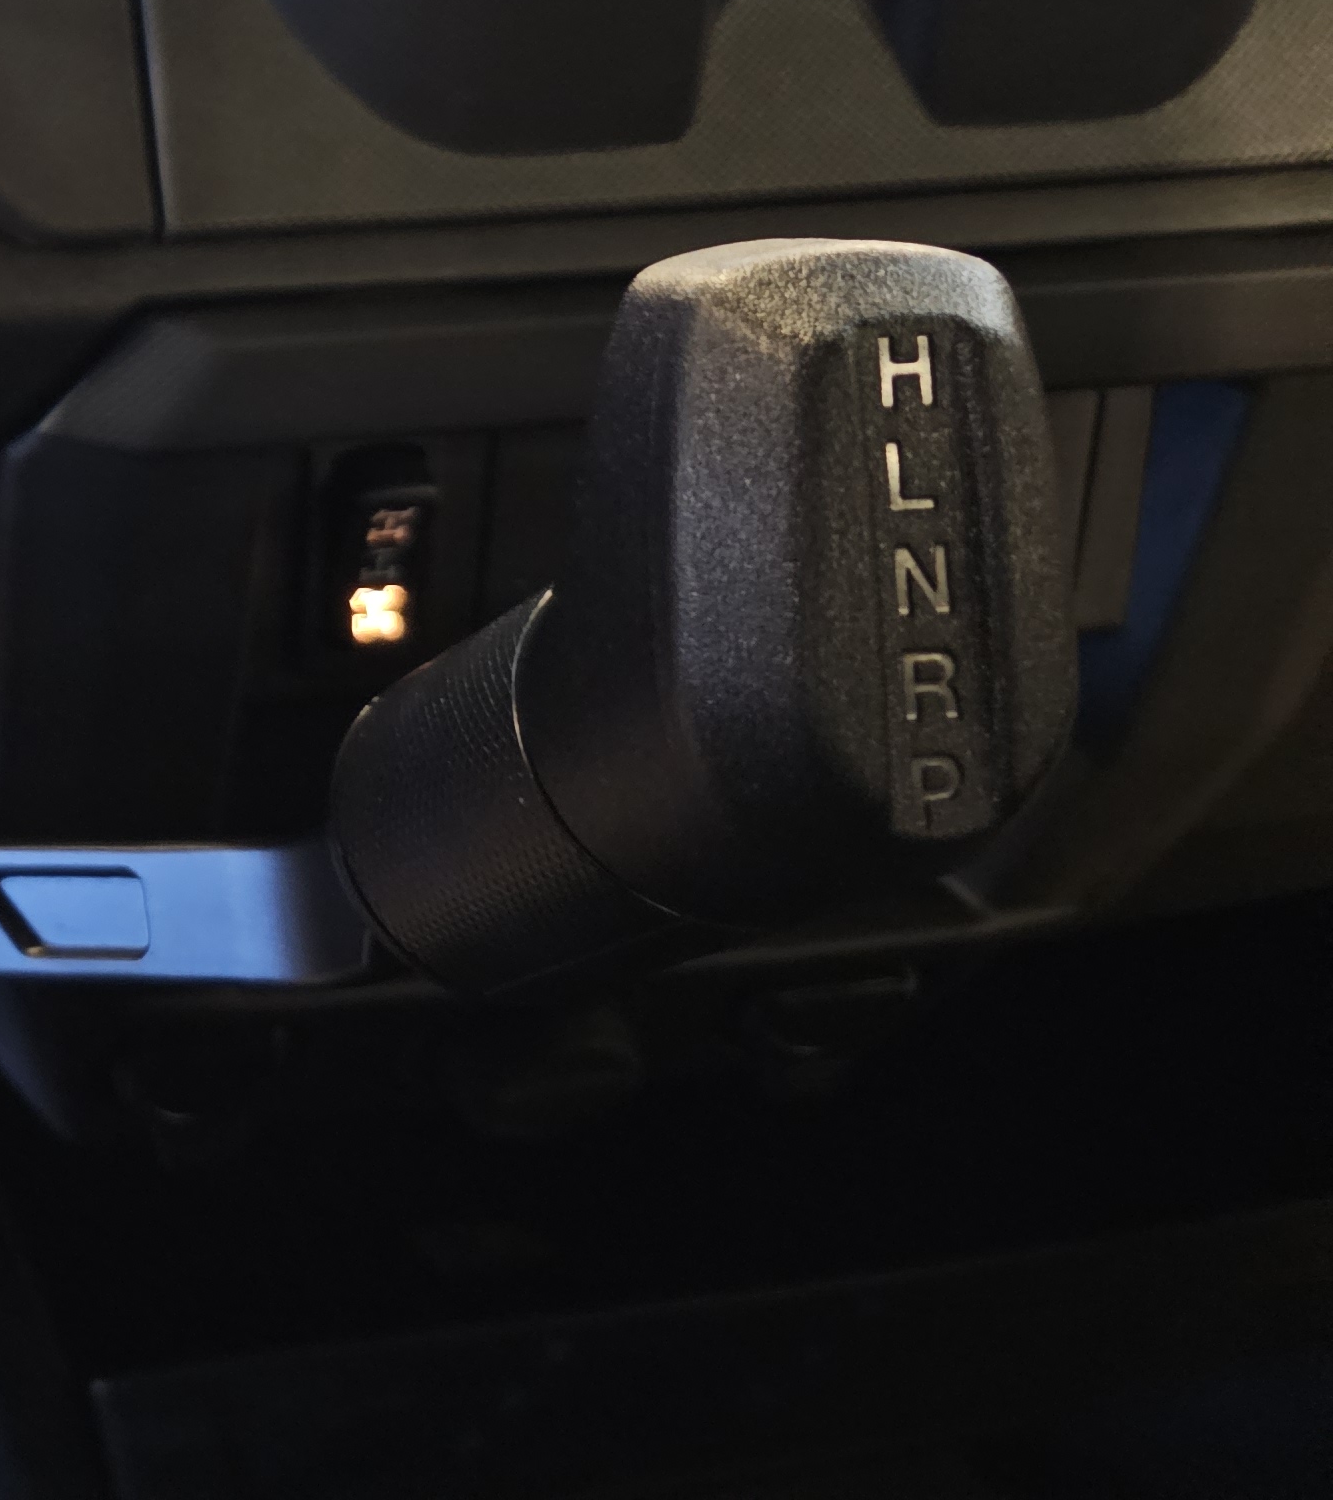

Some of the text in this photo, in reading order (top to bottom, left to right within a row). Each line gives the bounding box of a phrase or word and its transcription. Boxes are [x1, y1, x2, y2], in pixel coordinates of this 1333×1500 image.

[878, 335, 933, 408] H
[885, 442, 934, 511] L
[894, 545, 950, 615] N
[901, 652, 959, 721] R
